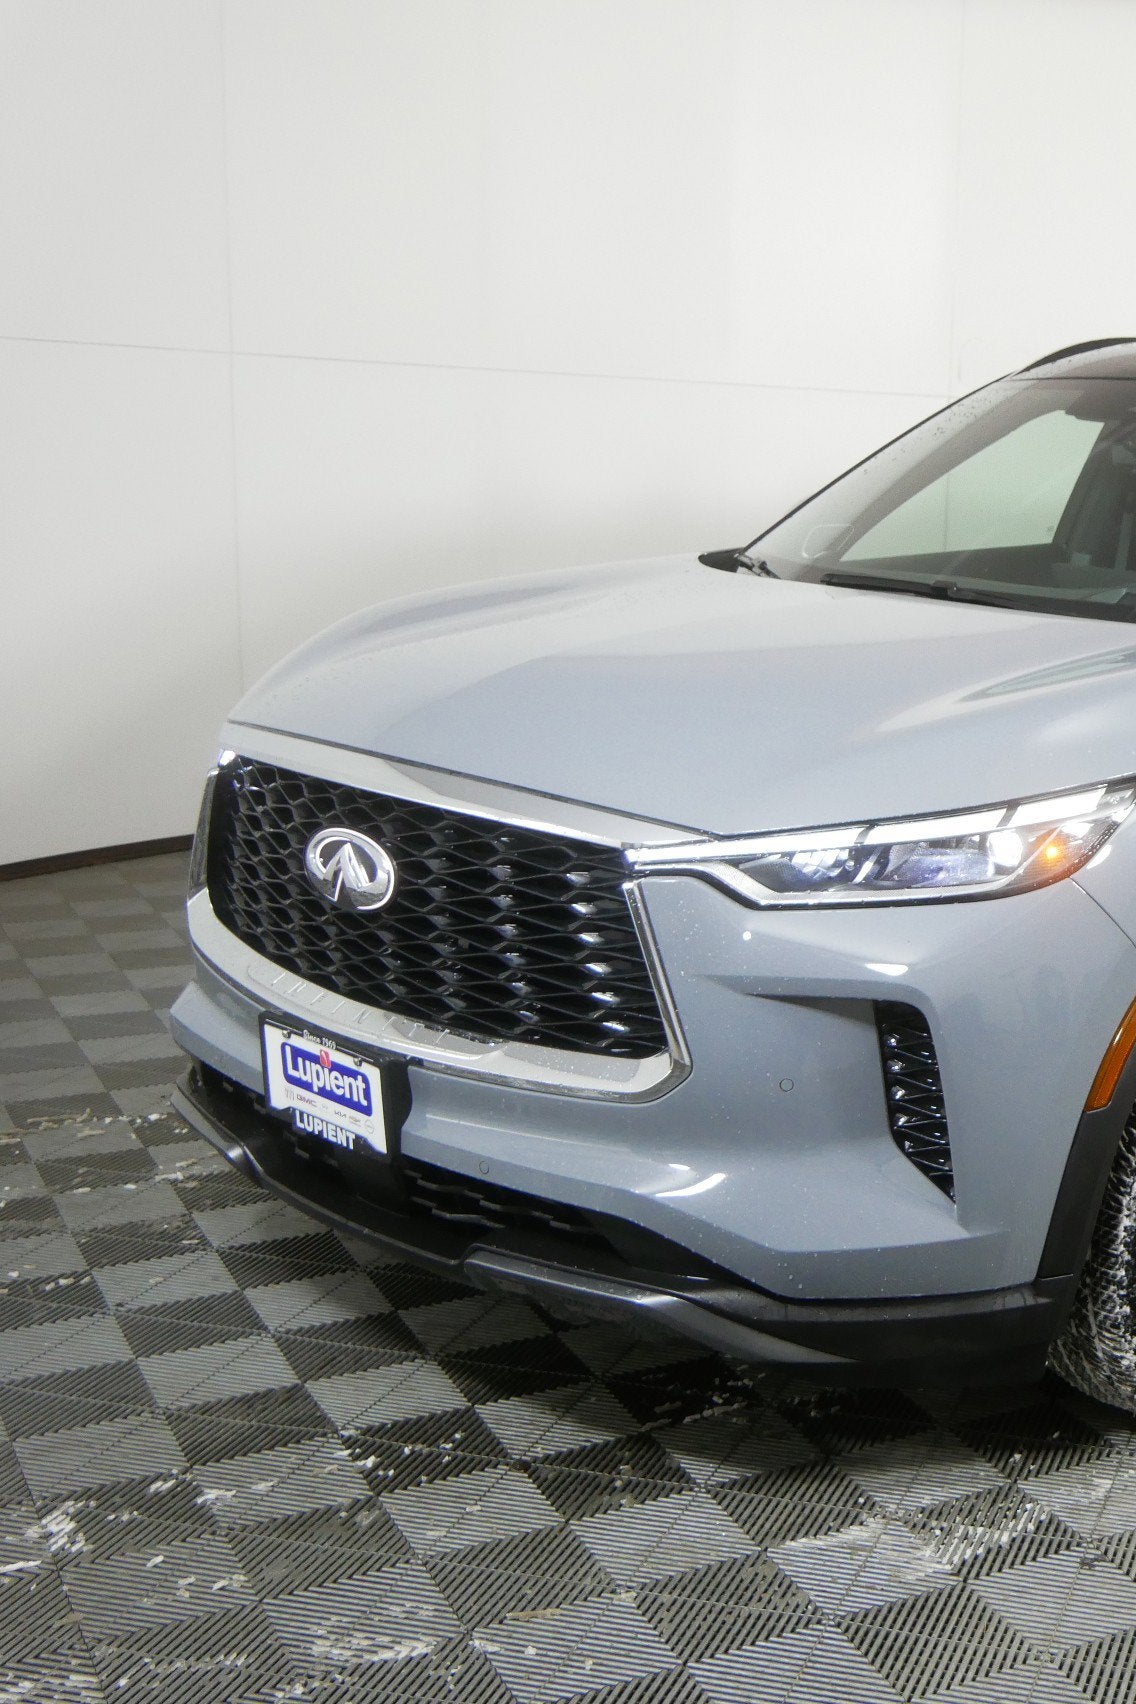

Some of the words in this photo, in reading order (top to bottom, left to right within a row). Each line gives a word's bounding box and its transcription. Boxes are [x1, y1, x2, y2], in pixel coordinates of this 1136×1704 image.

[303, 1029, 321, 1044] Since
[284, 1043, 368, 1107] Lupient
[296, 1093, 318, 1108] GMC
[295, 1109, 356, 1150] LUPIENT
